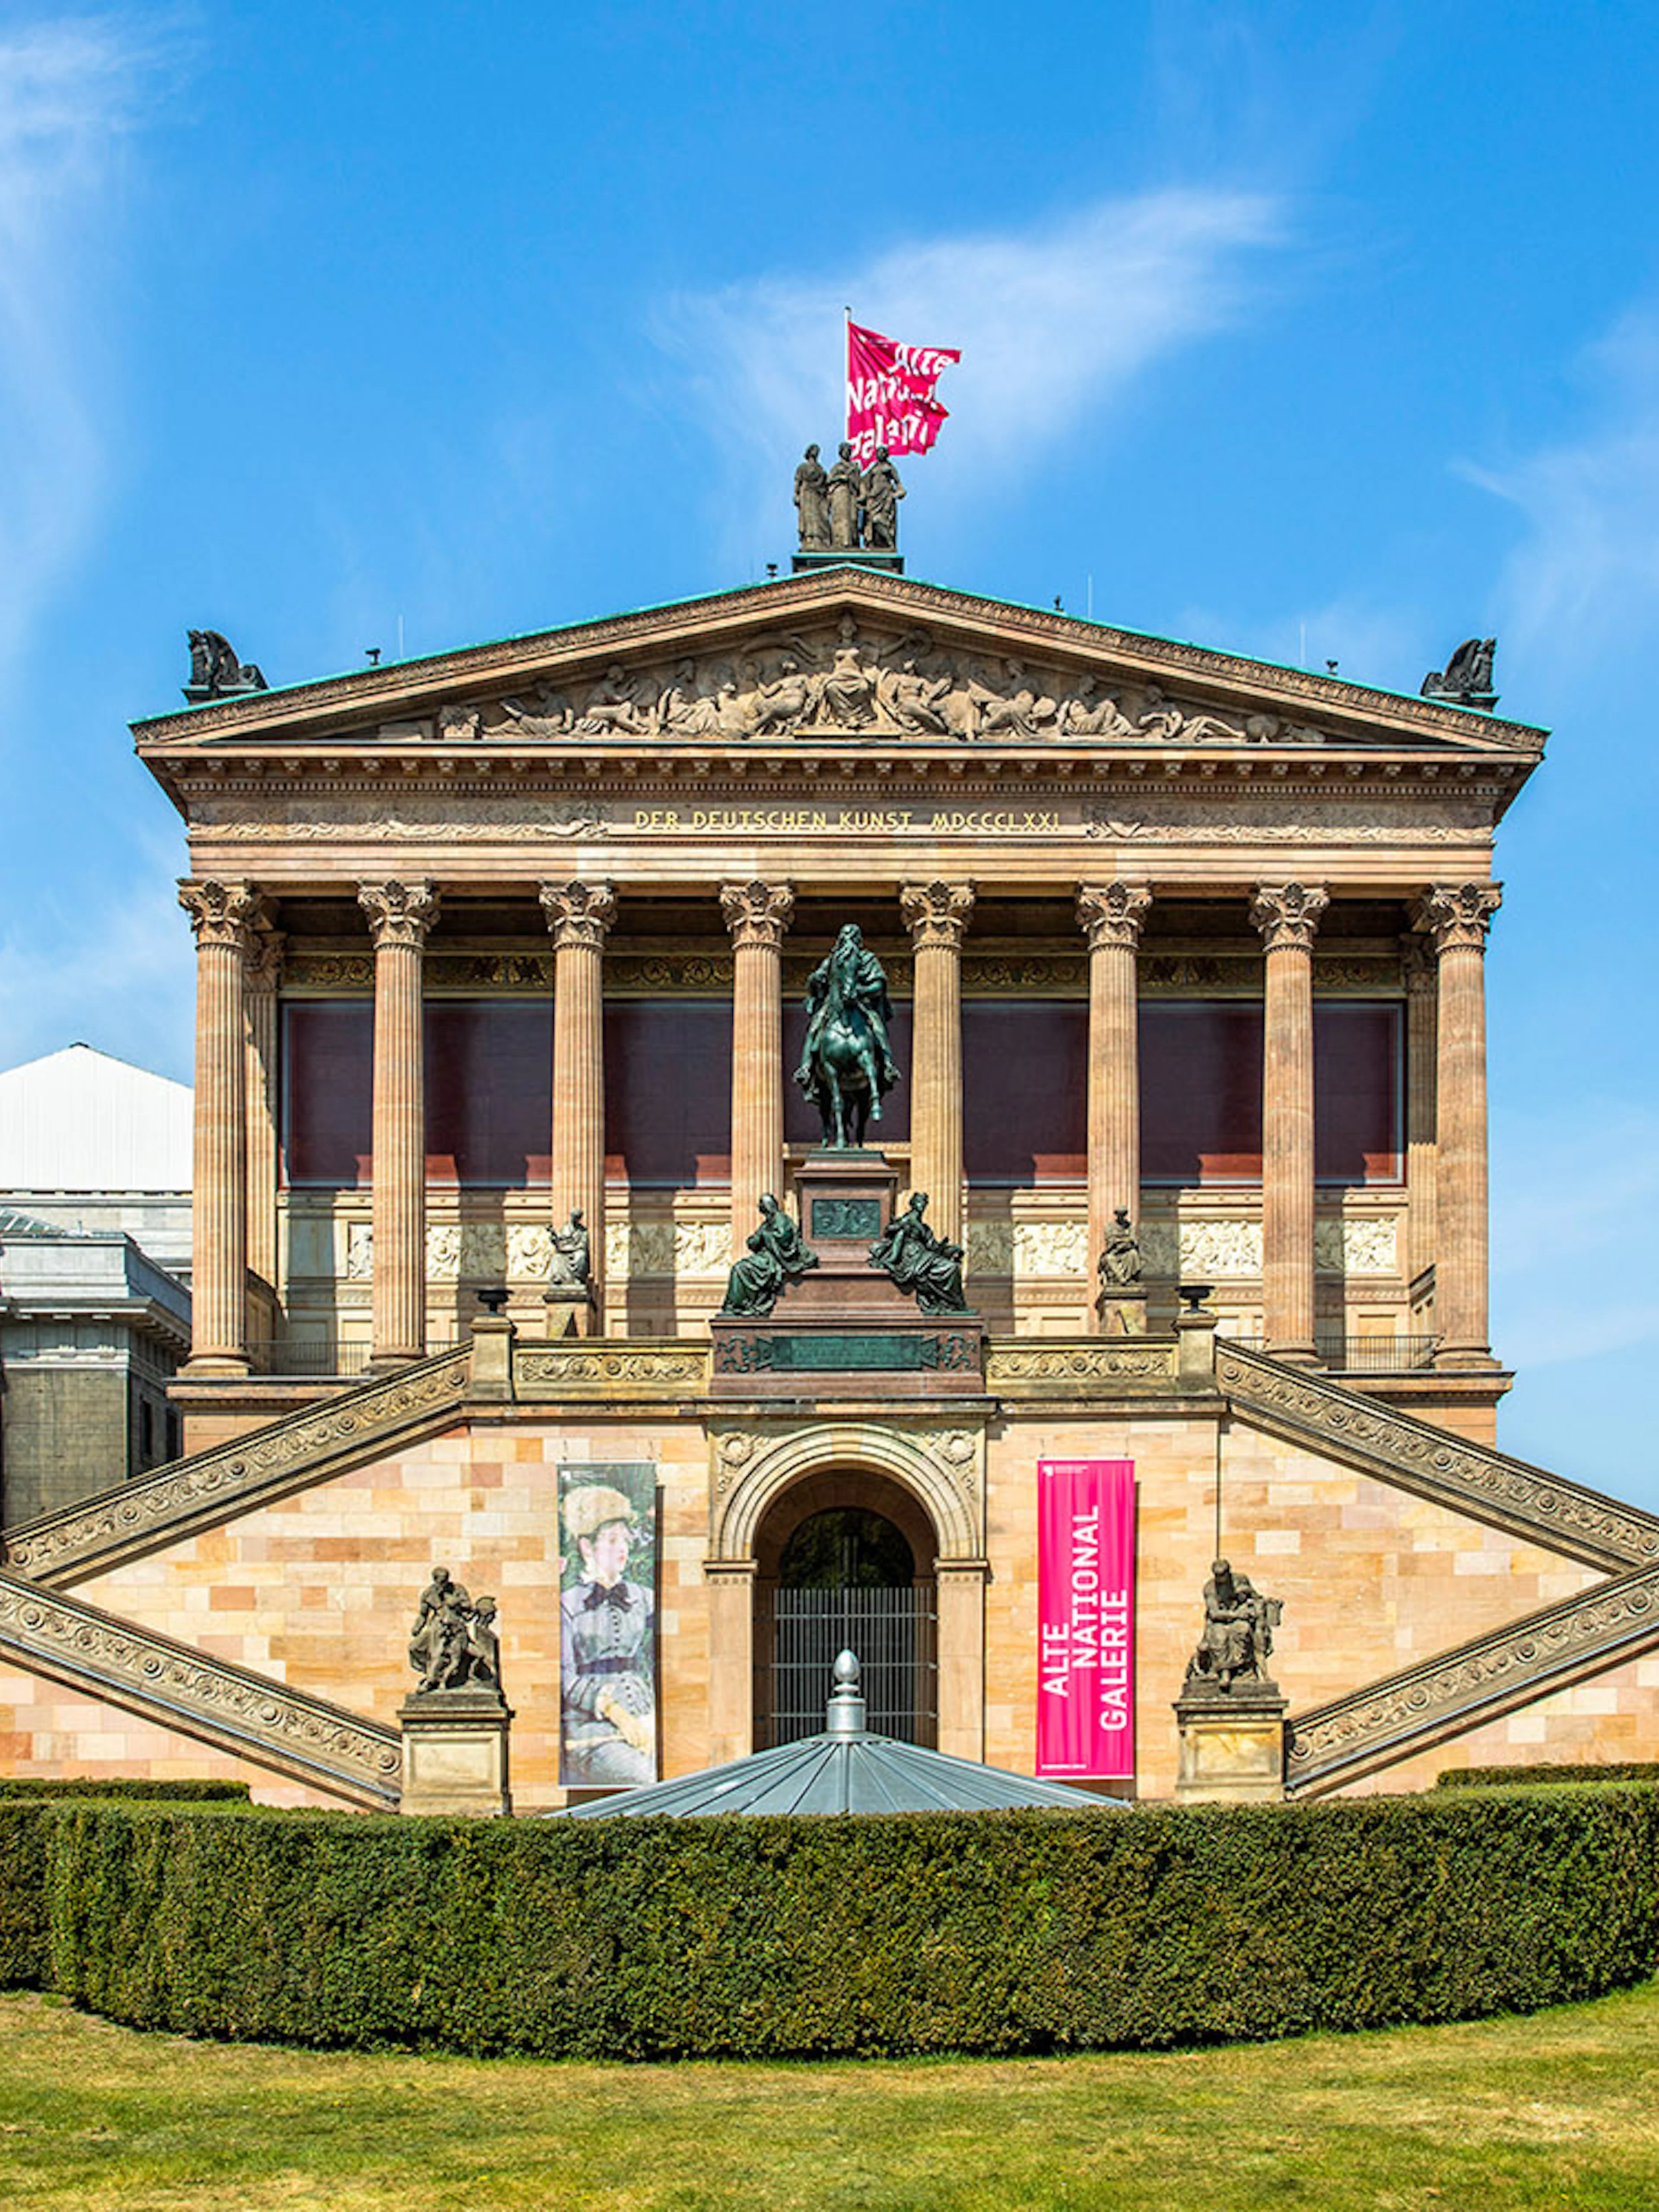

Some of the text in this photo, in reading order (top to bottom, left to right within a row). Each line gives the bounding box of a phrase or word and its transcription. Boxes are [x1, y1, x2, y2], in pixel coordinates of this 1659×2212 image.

[887, 343, 955, 376] Alte
[635, 810, 1059, 830] DER DEUTSCHEN KUNST MDCCCLXXI
[1072, 1505, 1098, 1668] NATIONAL
[1042, 1623, 1069, 1697] ALTE
[1100, 1589, 1127, 1730] GALERIE
